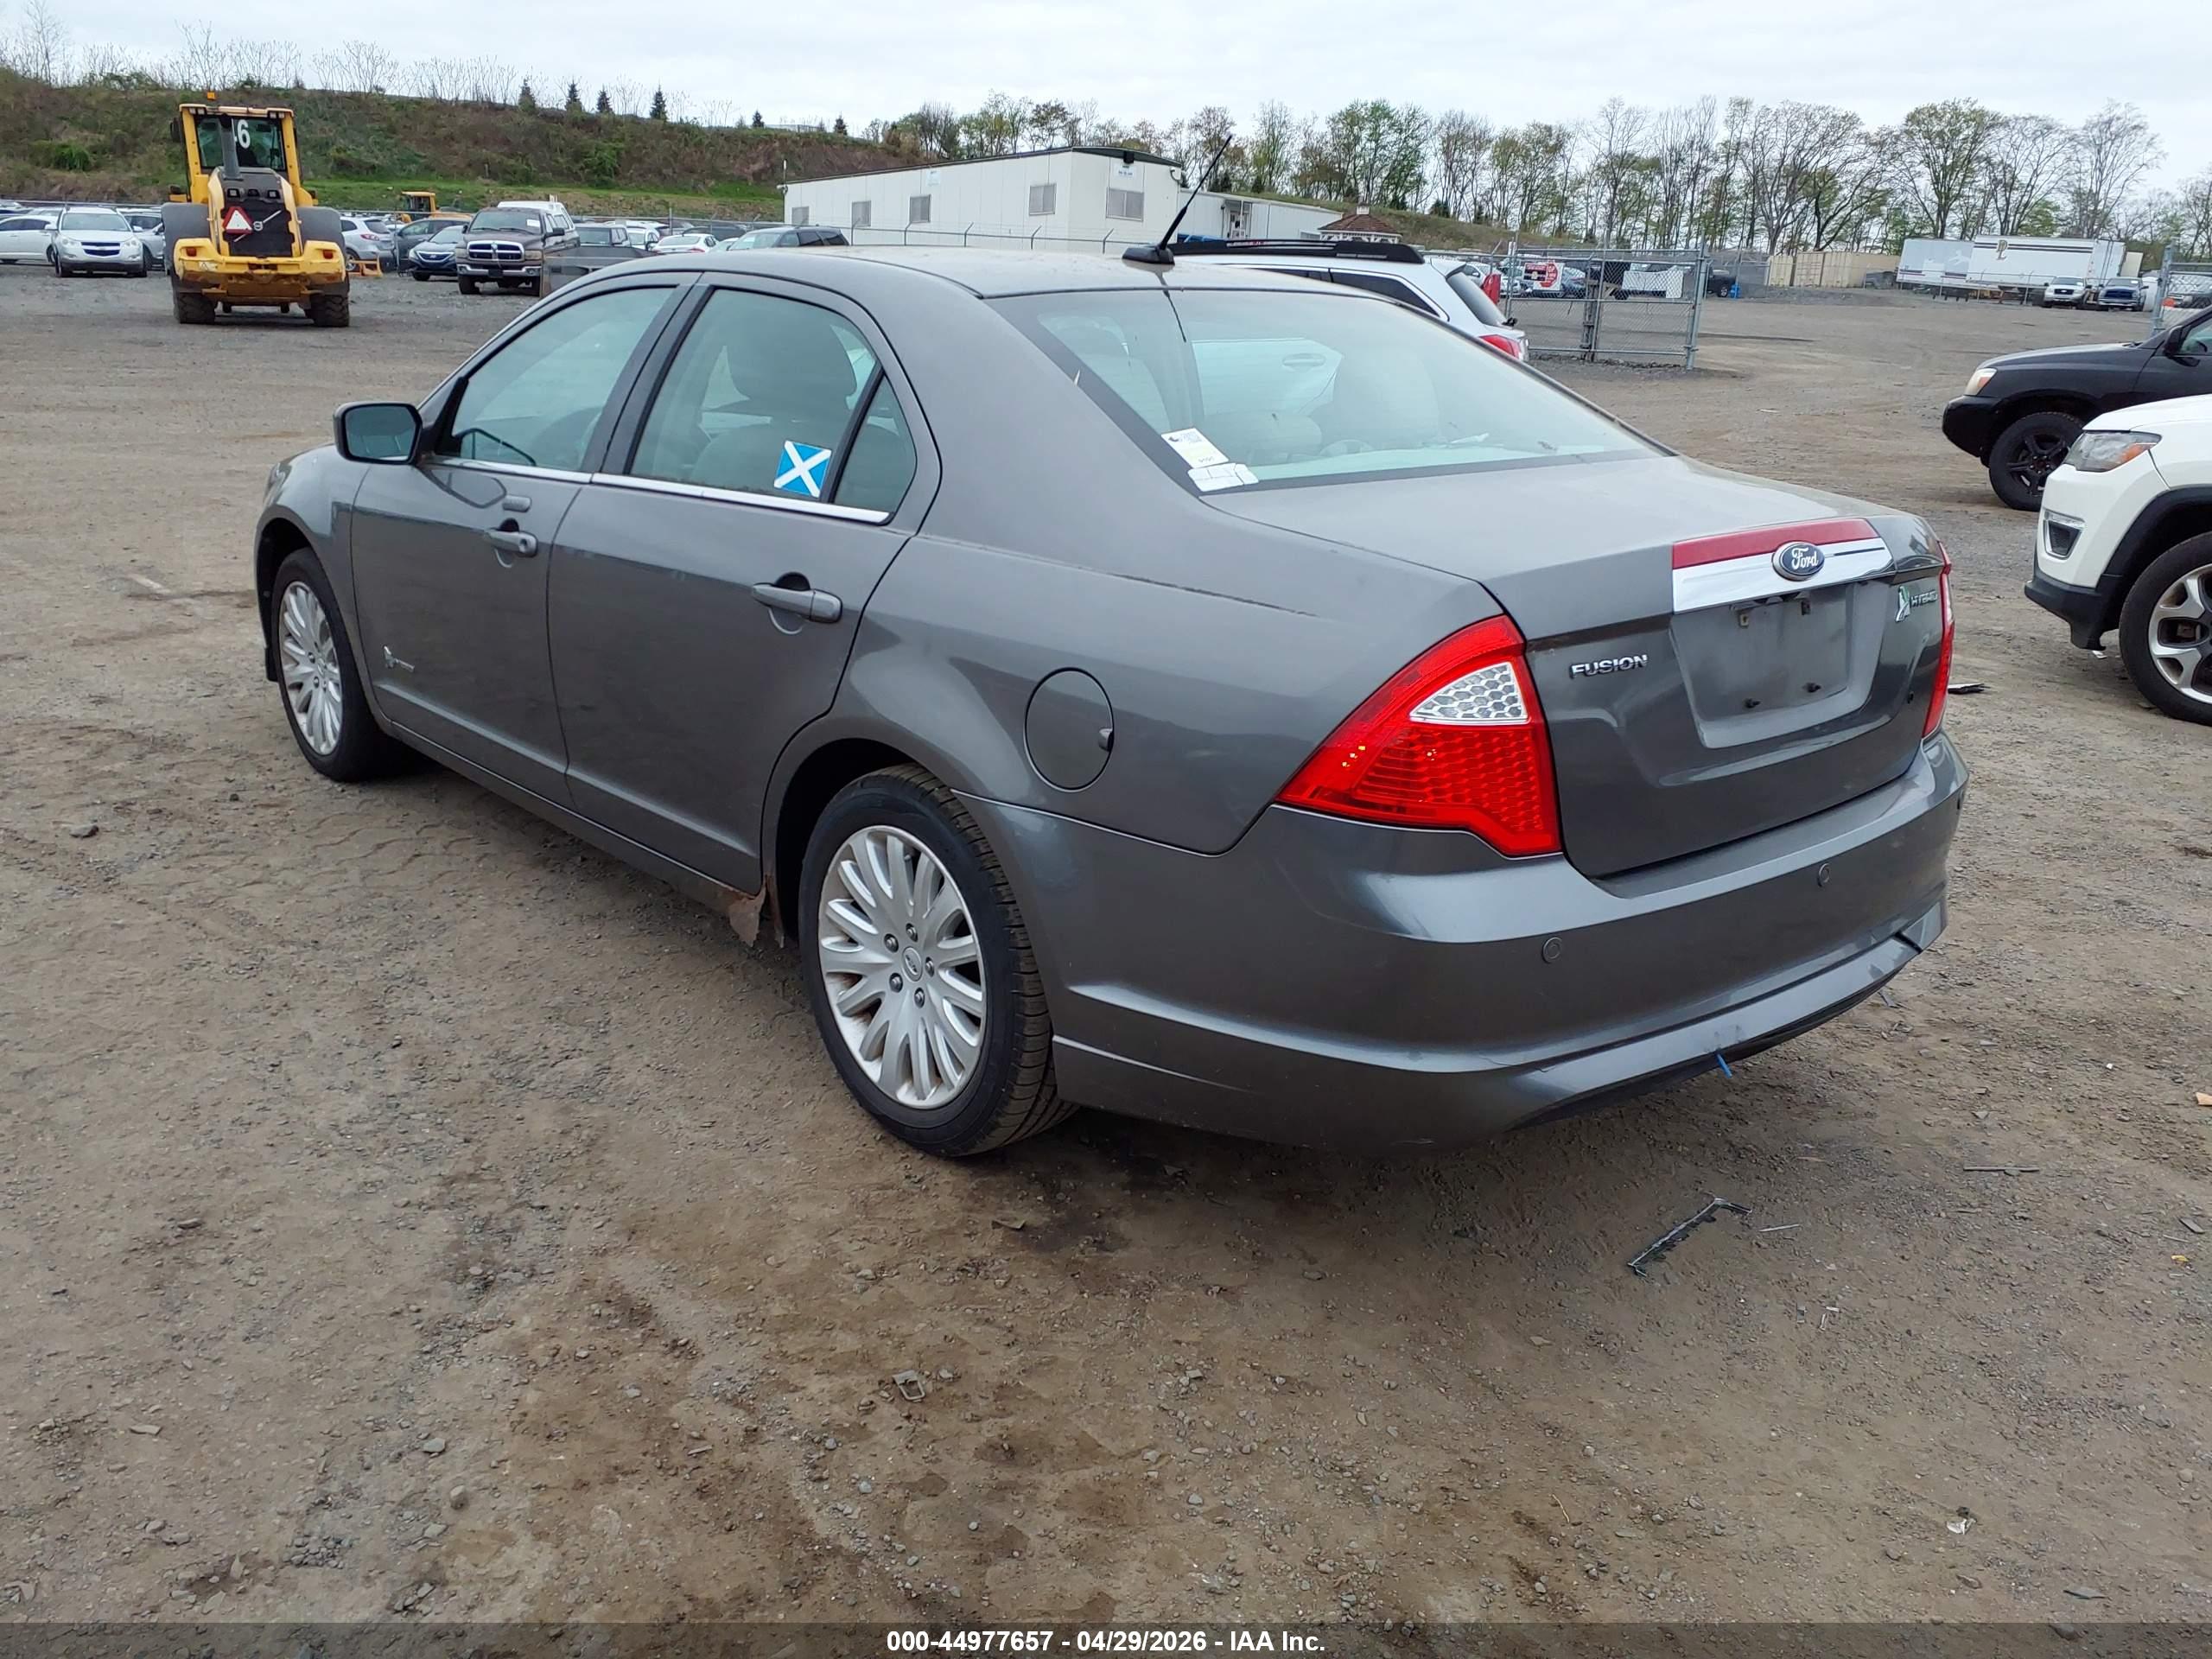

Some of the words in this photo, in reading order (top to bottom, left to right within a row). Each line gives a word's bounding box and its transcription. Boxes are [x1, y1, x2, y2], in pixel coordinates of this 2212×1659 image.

[234, 118, 251, 149] 6
[1791, 547, 1819, 570] Ford
[1570, 654, 1648, 678] FUSION
